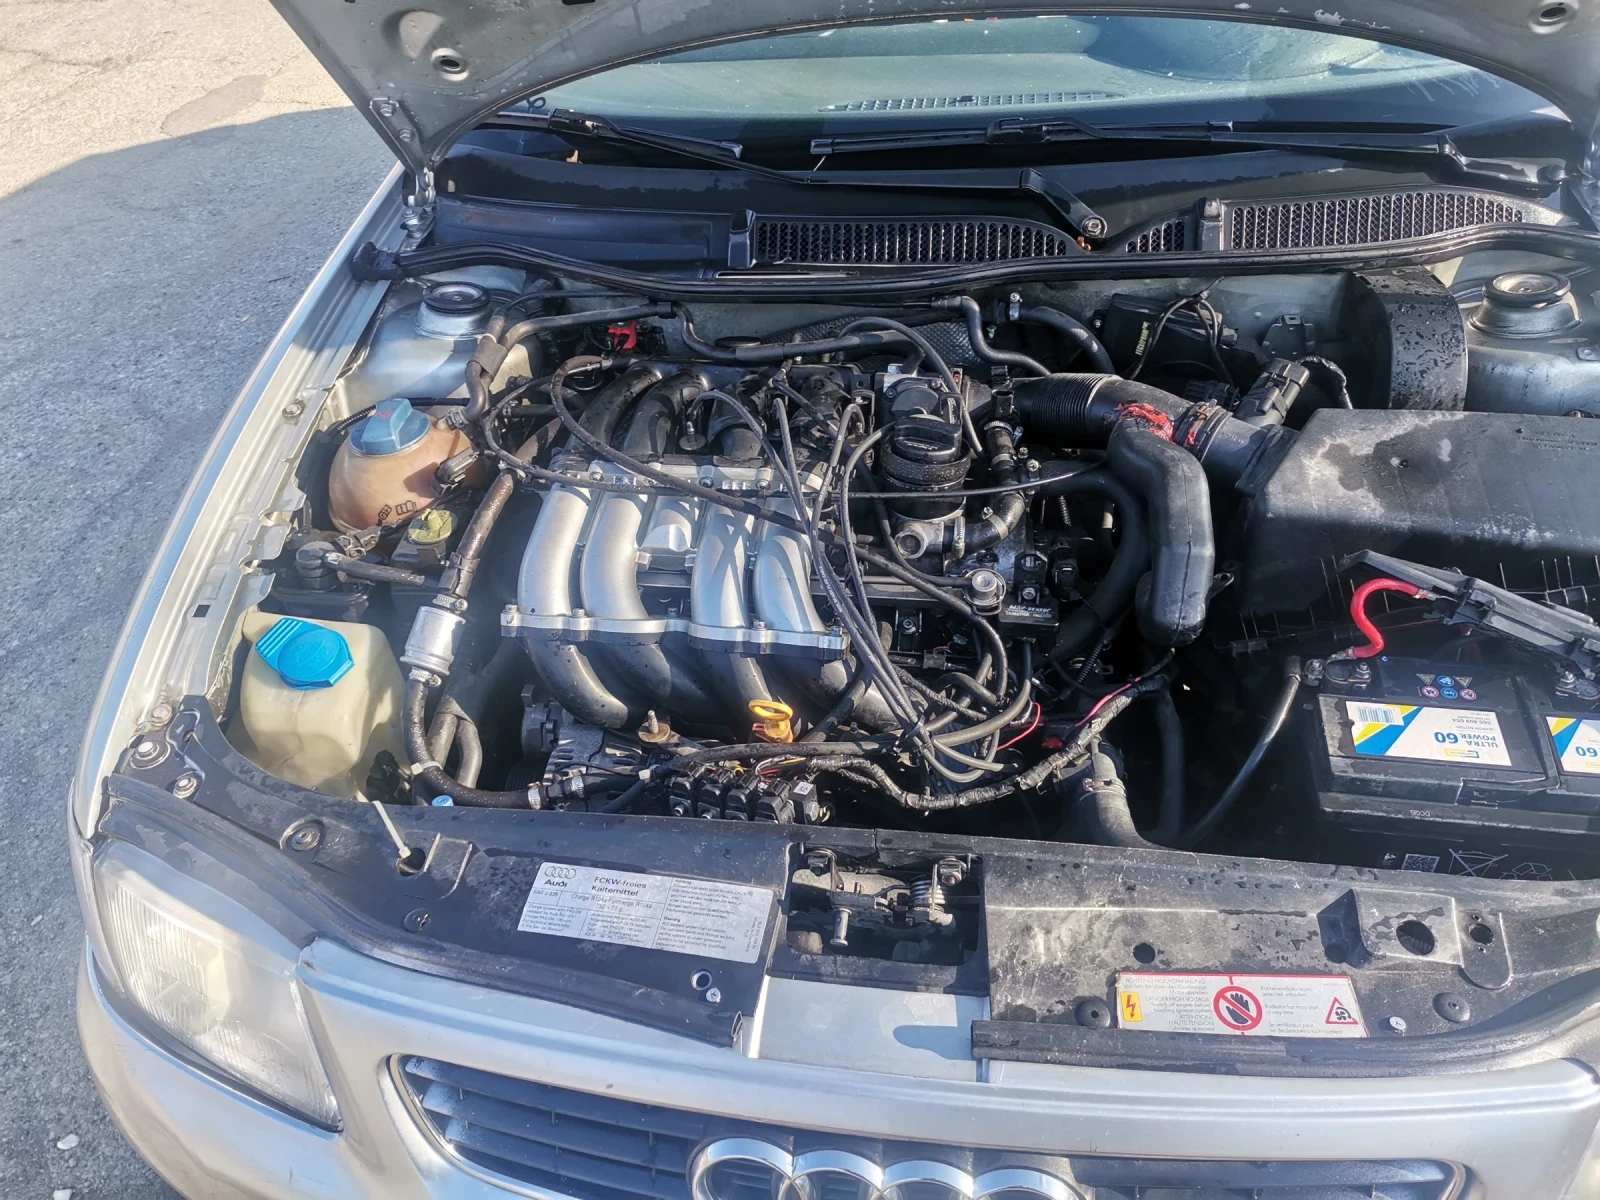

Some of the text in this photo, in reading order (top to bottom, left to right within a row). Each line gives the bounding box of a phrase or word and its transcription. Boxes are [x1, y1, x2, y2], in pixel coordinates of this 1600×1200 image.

[1433, 731, 1459, 744] 60
[1576, 746, 1598, 758] 60
[544, 879, 568, 887] Audi
[594, 876, 647, 888] FCKW-freies
[591, 885, 638, 896] Kältemittel
